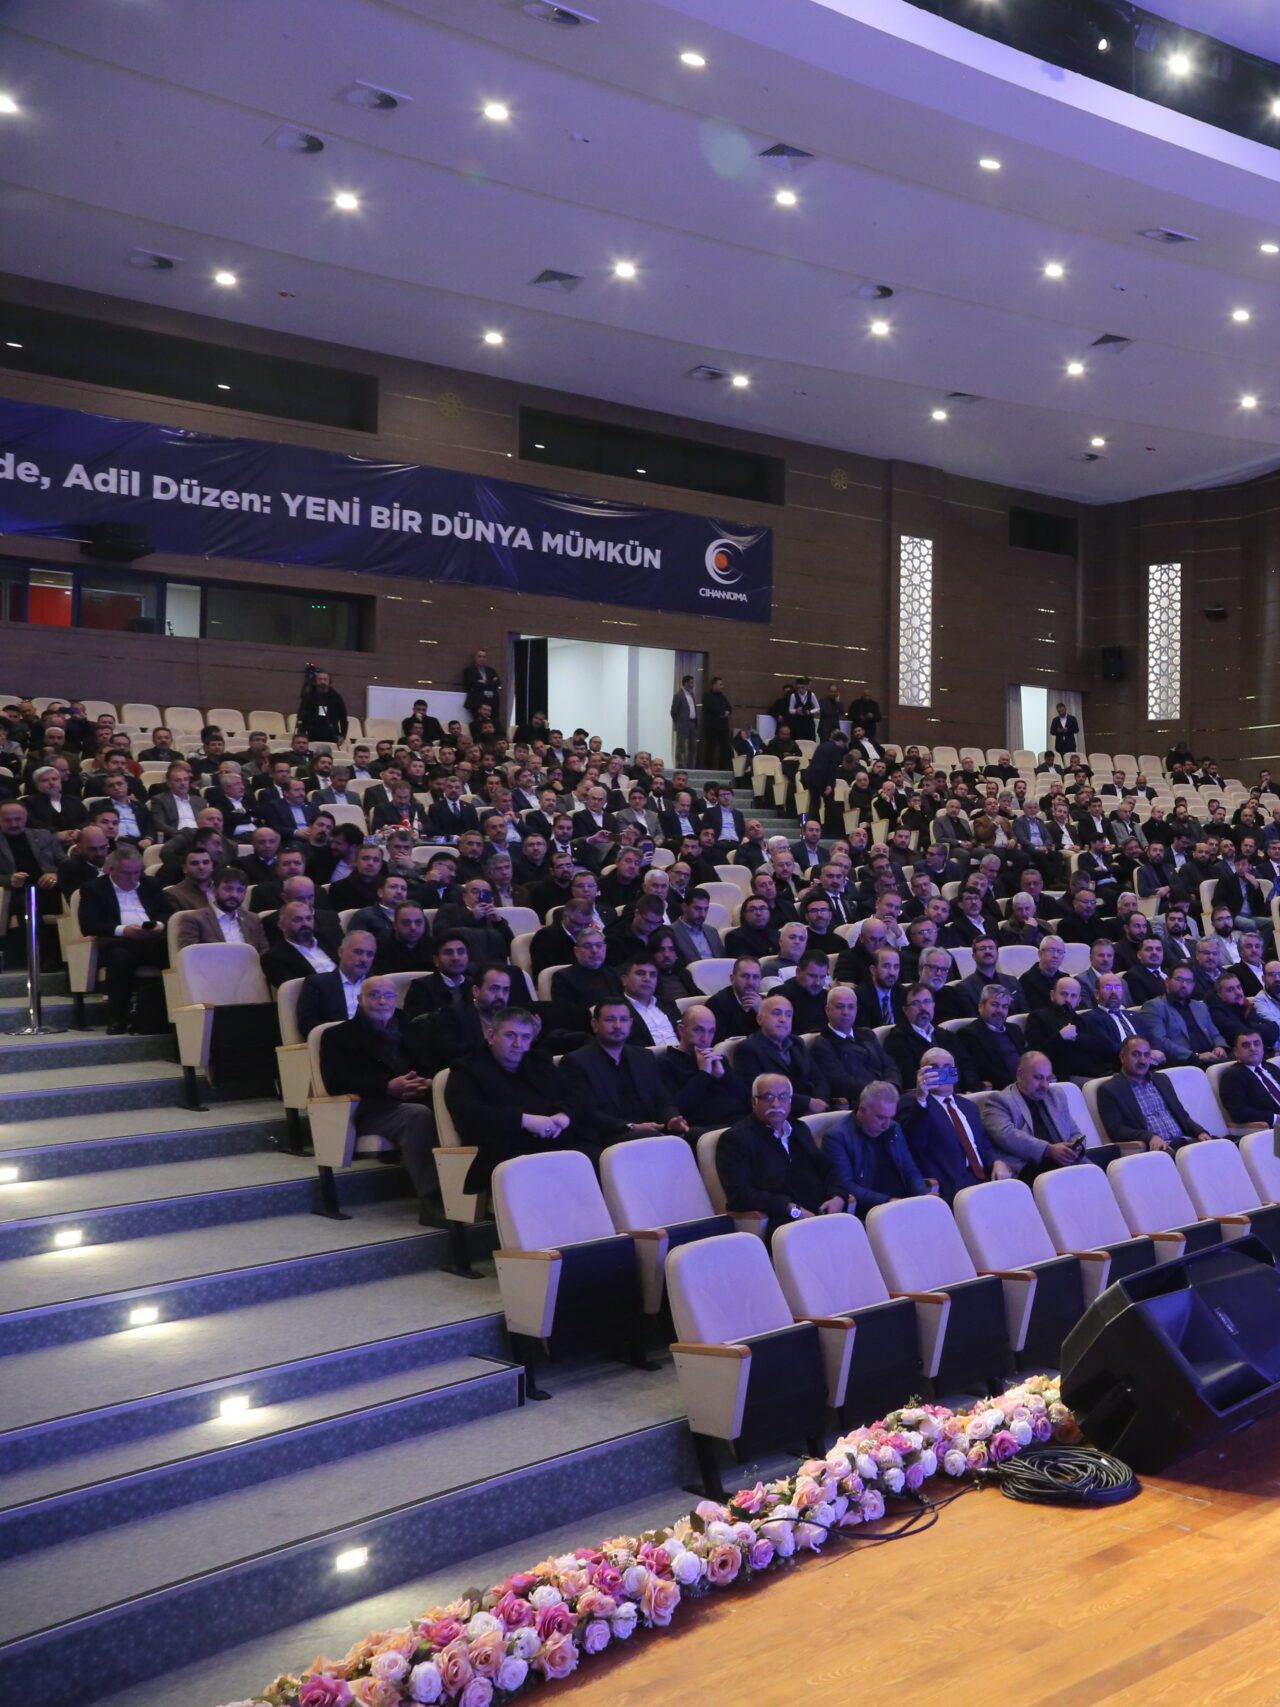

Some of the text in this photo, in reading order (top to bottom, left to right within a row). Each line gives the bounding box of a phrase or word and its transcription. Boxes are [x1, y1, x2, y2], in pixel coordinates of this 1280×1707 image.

[62, 463, 140, 497] Adil
[152, 474, 272, 514] Düzen:
[281, 492, 360, 526] YENİ
[370, 501, 422, 534] BİR
[431, 511, 533, 551] DÜNYA
[541, 530, 661, 570] MÜMKÜN
